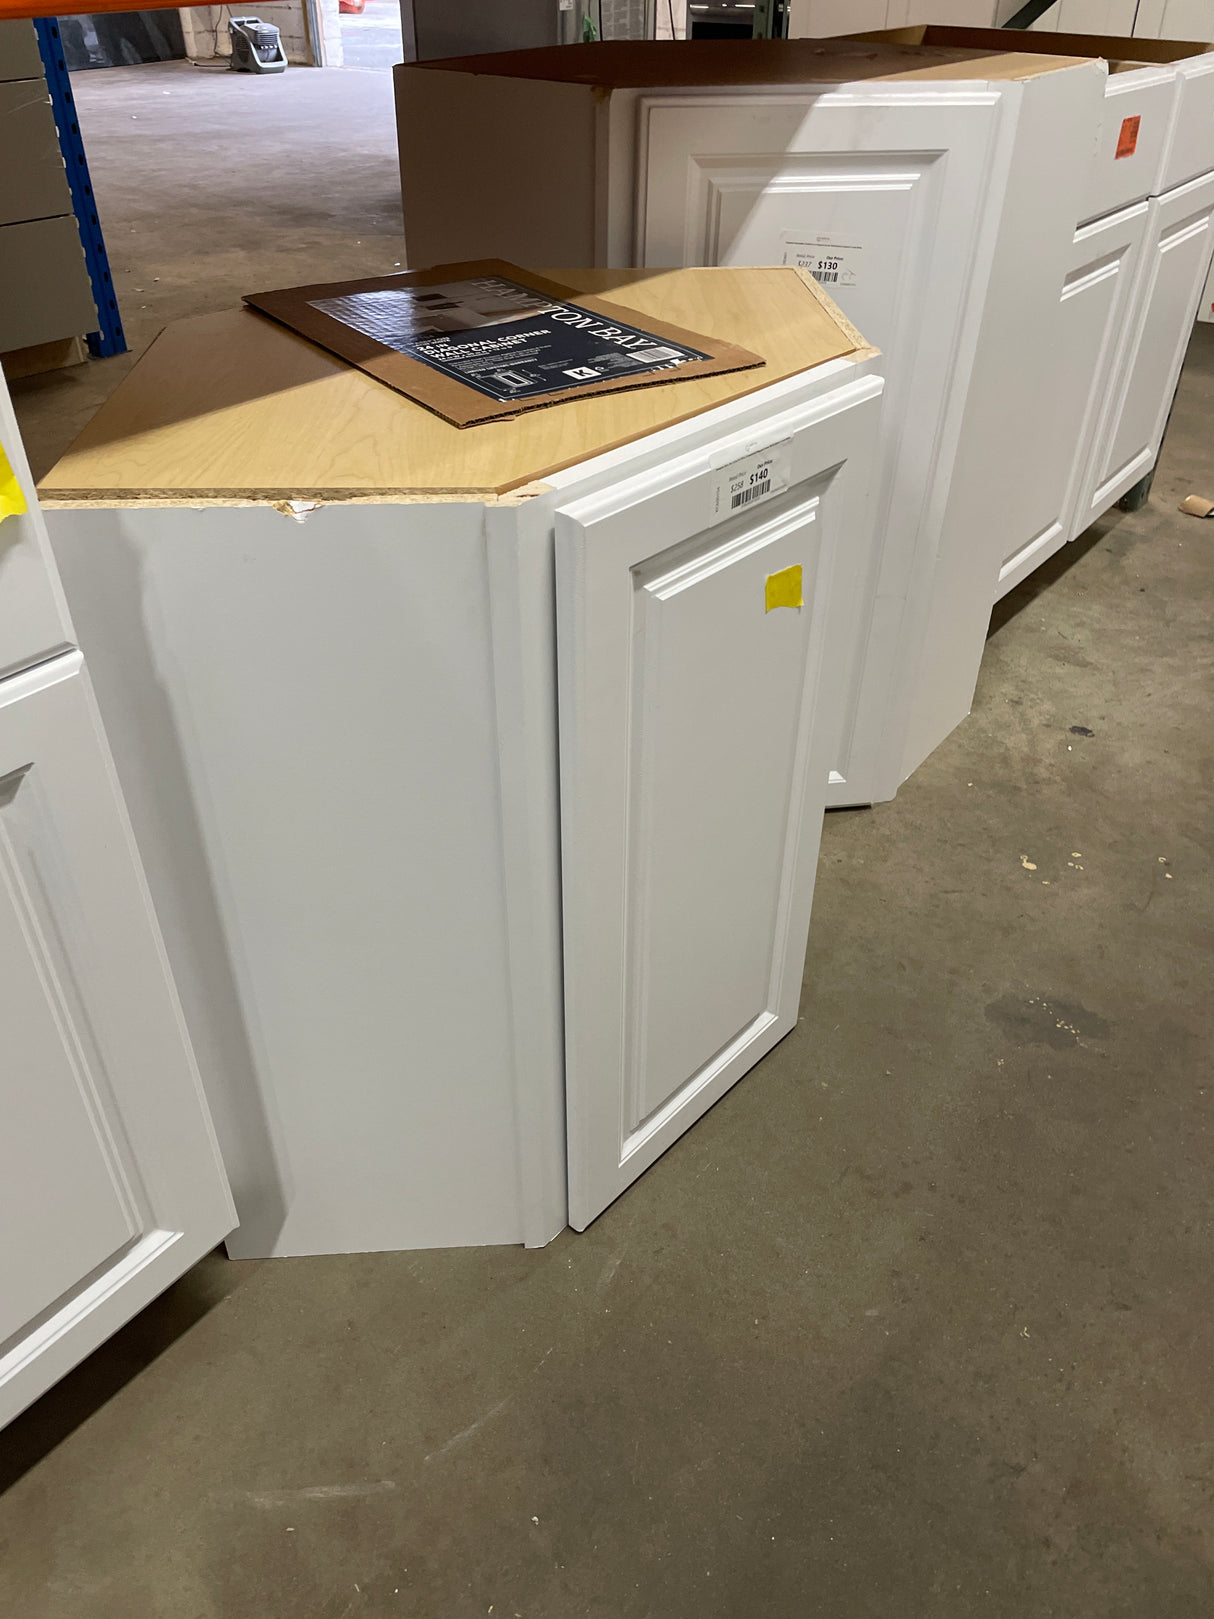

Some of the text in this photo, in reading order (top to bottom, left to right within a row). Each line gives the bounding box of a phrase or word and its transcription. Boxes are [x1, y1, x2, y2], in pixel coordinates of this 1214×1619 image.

[818, 260, 838, 270] $130
[471, 279, 657, 350] HAMPTON BAY
[424, 339, 497, 355] DIAGONAL
[497, 329, 551, 342] CORNER
[430, 349, 470, 359] WALL
[471, 338, 527, 352] CABINET
[572, 369, 592, 377] K
[749, 468, 768, 485] $140
[730, 480, 744, 493] $258
